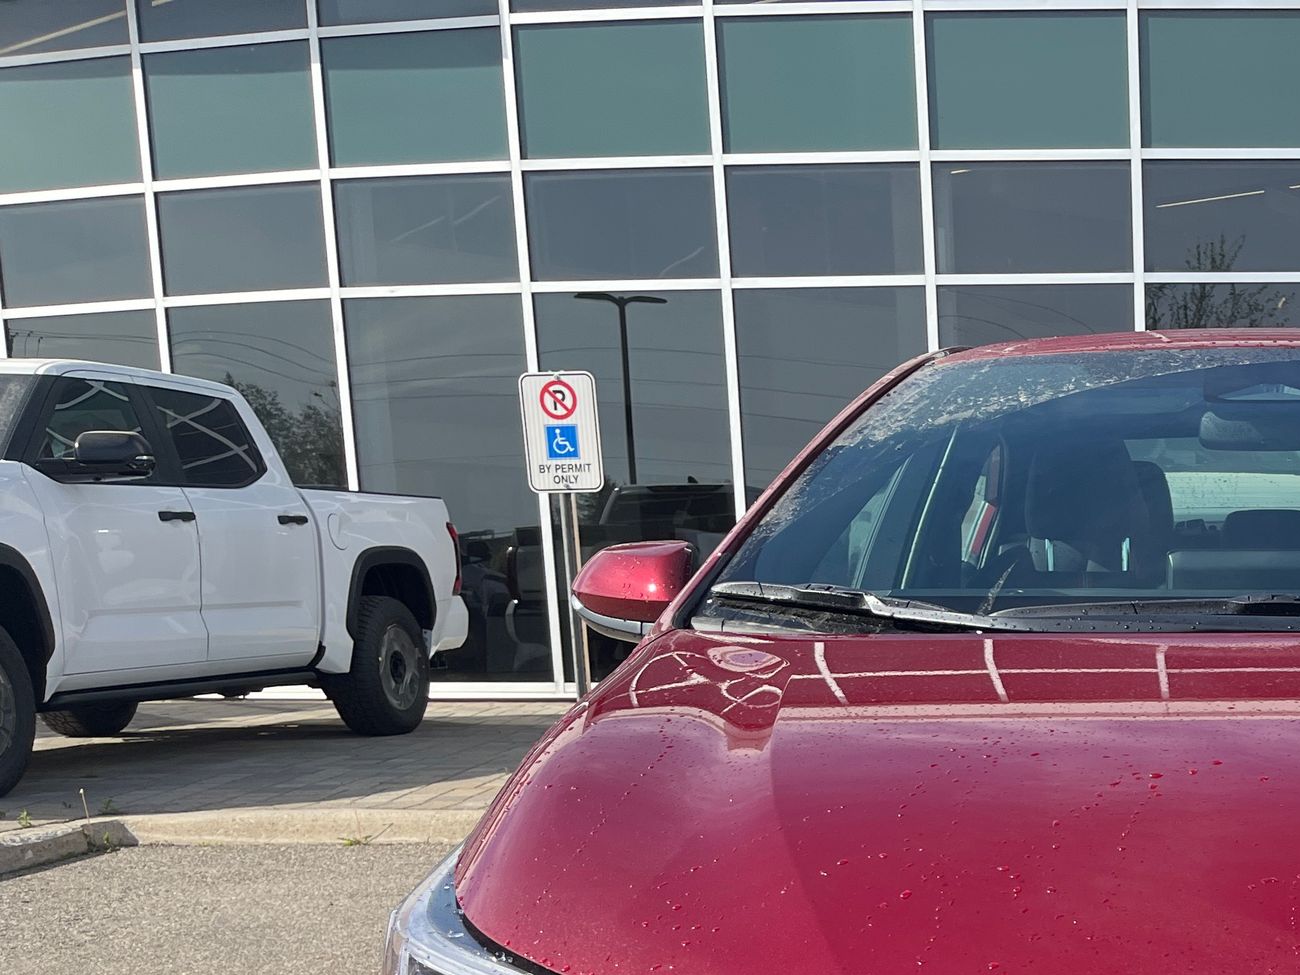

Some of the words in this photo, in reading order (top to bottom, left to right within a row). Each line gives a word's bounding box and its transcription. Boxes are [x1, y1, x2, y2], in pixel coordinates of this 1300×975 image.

[539, 464, 551, 473] BY
[555, 463, 592, 473] PERMIT
[553, 475, 578, 484] ONLY
